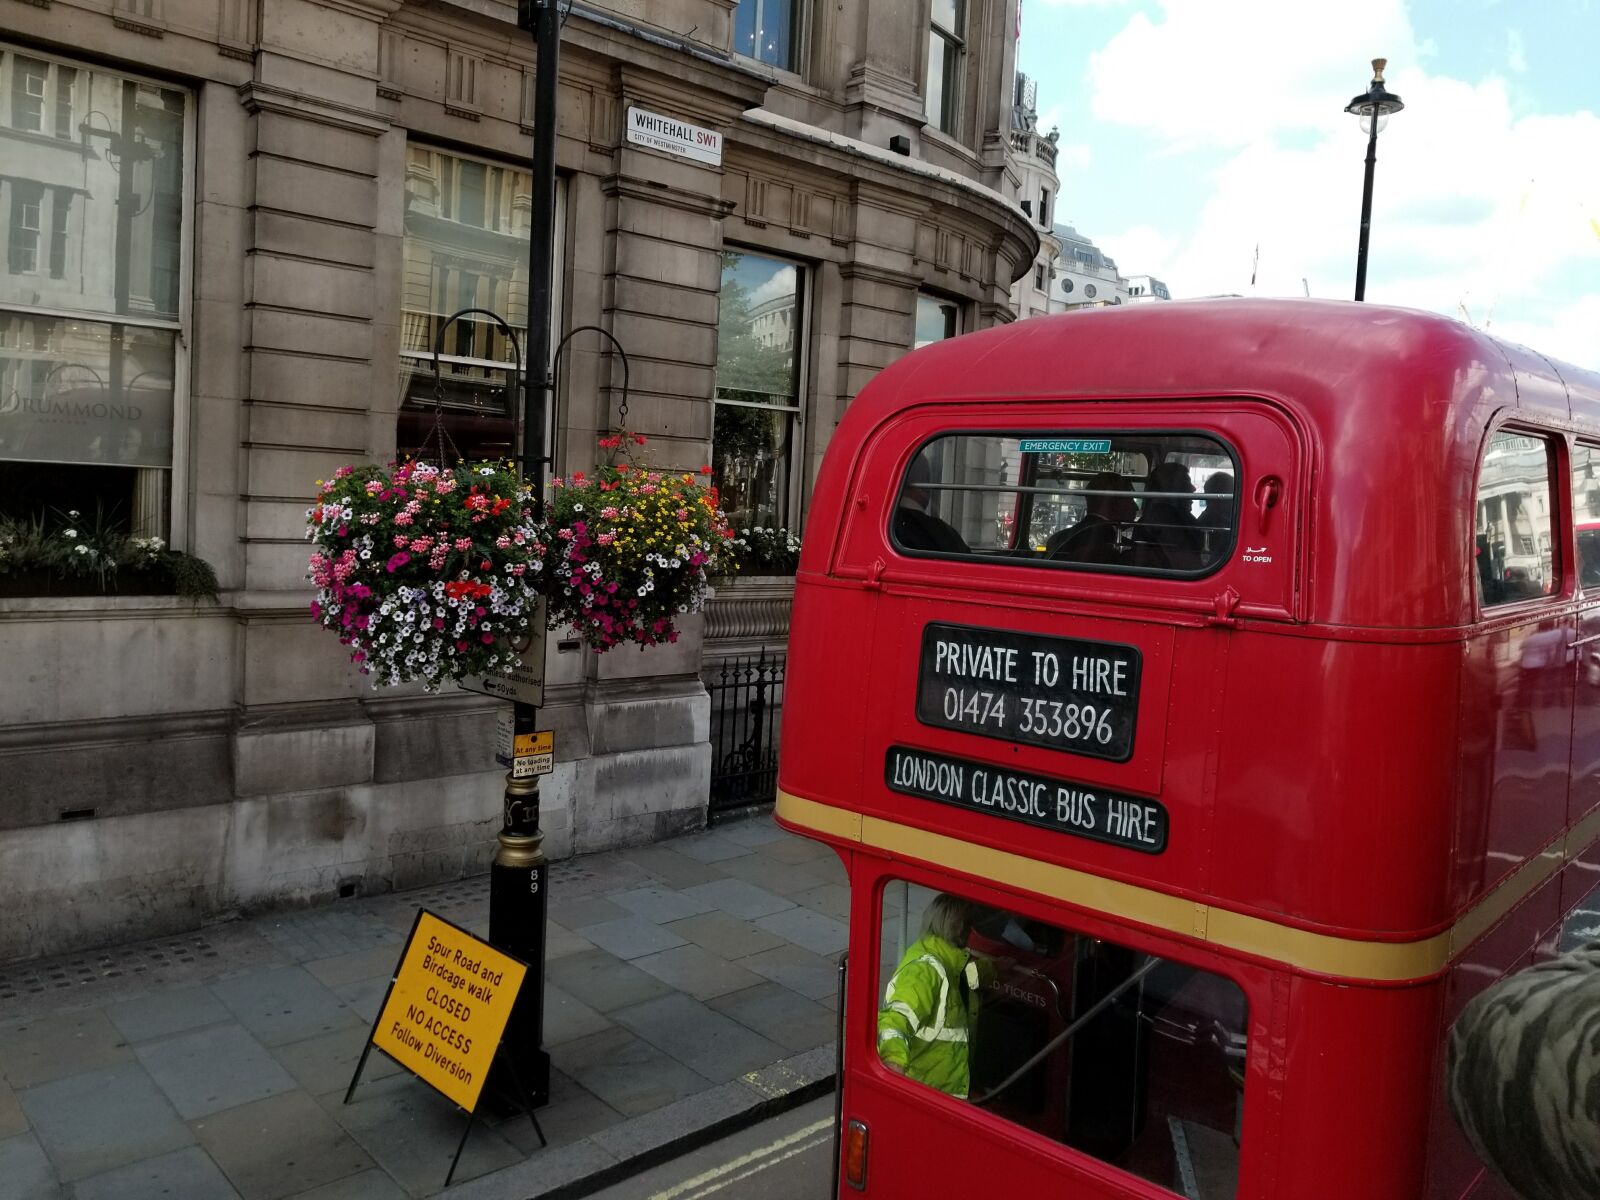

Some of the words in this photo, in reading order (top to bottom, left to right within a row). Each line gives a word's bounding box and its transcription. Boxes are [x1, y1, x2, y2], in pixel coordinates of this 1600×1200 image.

[634, 133, 645, 143] CITY
[646, 136, 652, 144] OF
[653, 137, 686, 154] WESTMINSTER
[635, 112, 694, 142] WHITEHALL
[696, 131, 717, 149] SW1
[1024, 442, 1080, 450] EMERGENCY
[1082, 442, 1105, 451] EXIT
[507, 672, 541, 687] authorised
[935, 640, 1018, 682] PRIVATE
[1031, 651, 1059, 687] TO
[1072, 656, 1128, 696] HIRE
[944, 687, 1006, 728] 01474
[1019, 697, 1113, 745] 353896
[528, 757, 550, 765] loading
[894, 753, 963, 799] LONDON
[971, 770, 1047, 818] CLASSIC
[1056, 788, 1096, 829] BUS
[1106, 798, 1157, 843] HIRE
[422, 955, 466, 990] Birdcage
[467, 981, 494, 1005] walk
[427, 935, 452, 958] Spur
[452, 948, 481, 974] Road
[480, 968, 504, 987] and
[426, 986, 471, 1023] CLOSED
[1004, 983, 1047, 1007] TICKETS
[406, 1003, 425, 1025] NO
[424, 1016, 473, 1054] ACCESS
[391, 1021, 424, 1052] Follow
[424, 1042, 472, 1086] Diversion
